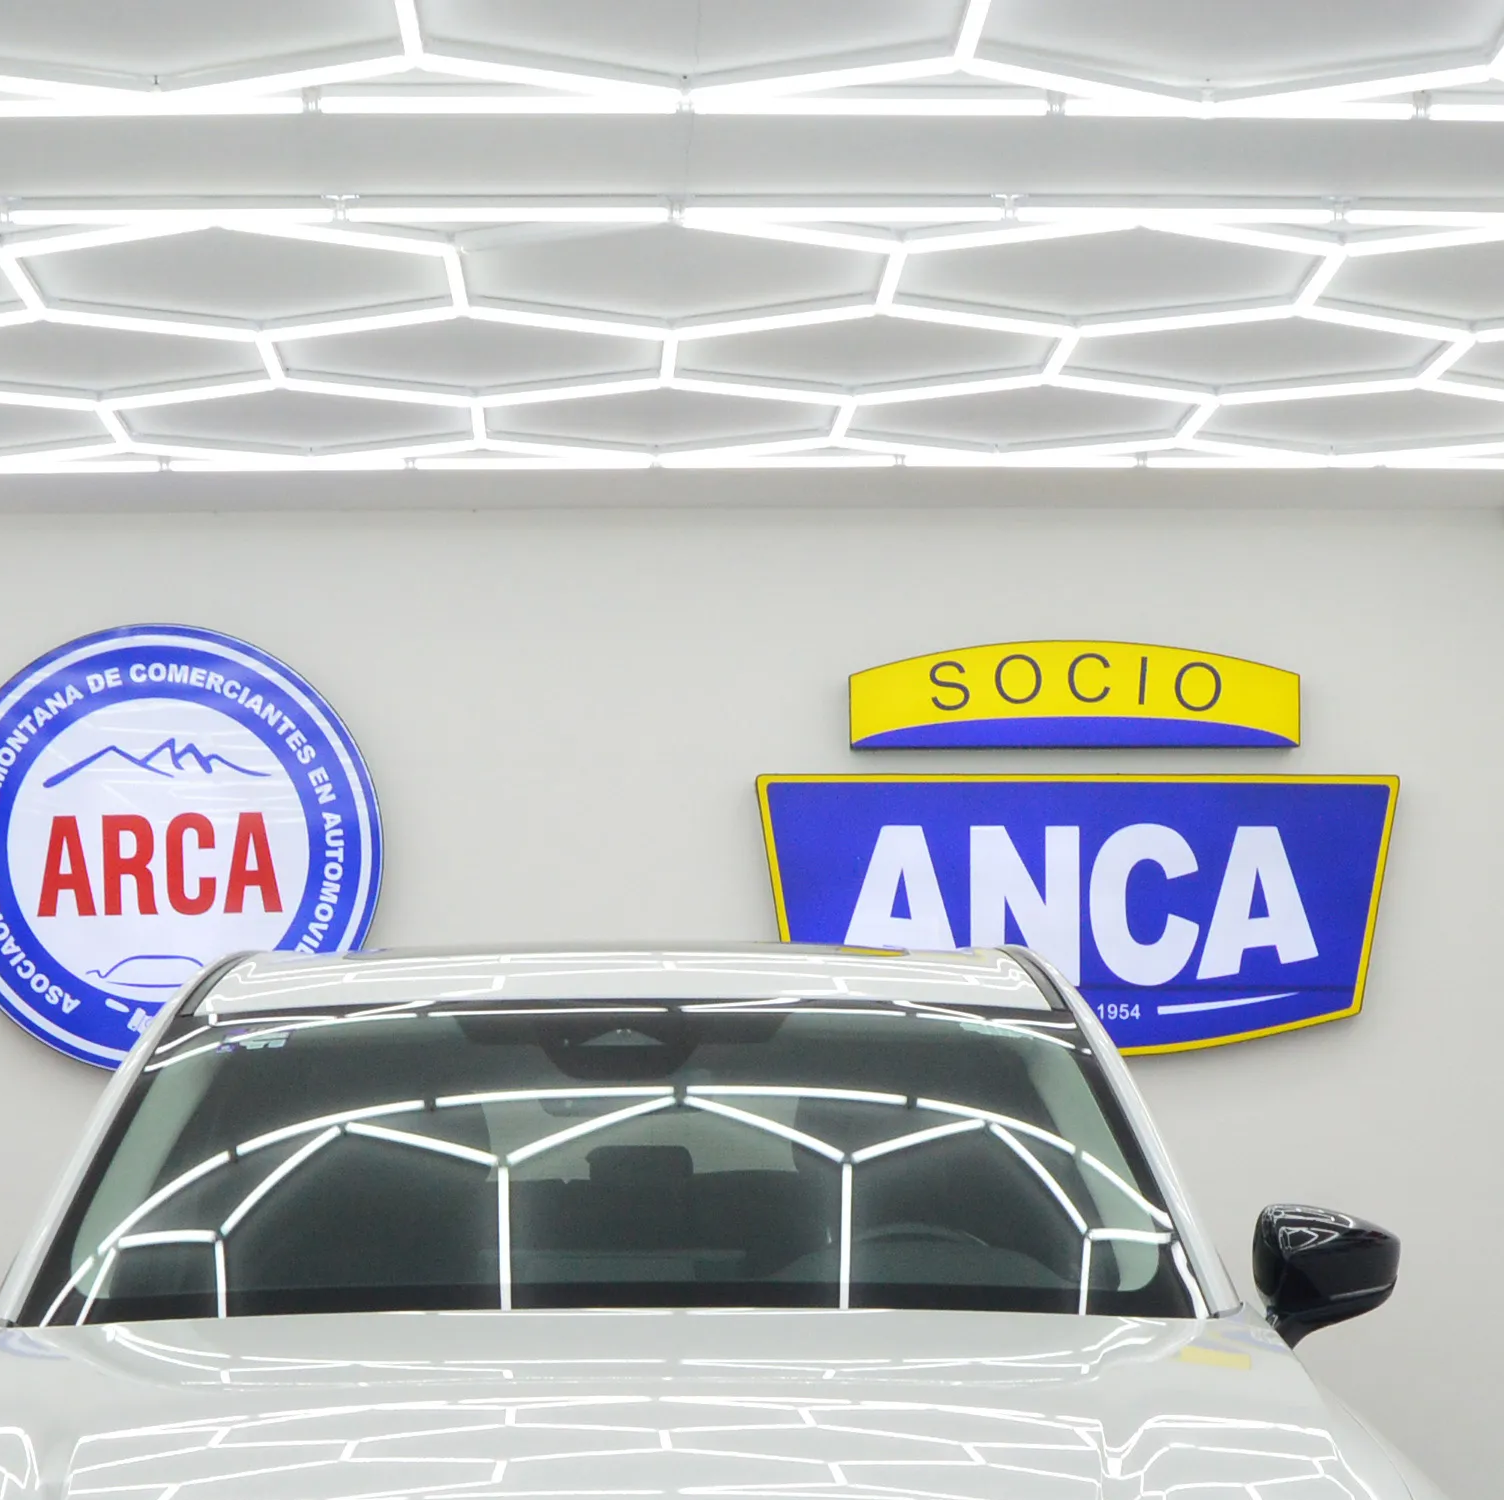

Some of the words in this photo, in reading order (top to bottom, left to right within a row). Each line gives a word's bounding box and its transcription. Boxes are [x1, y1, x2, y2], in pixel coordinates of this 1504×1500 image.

[86, 667, 123, 694] DE
[129, 662, 317, 765] COMERCIANTES
[307, 766, 336, 805] EN
[929, 652, 1222, 711] SOCIO
[36, 811, 284, 918] ARCA
[843, 822, 1318, 987] ANCA
[1097, 1003, 1141, 1020] 1954
